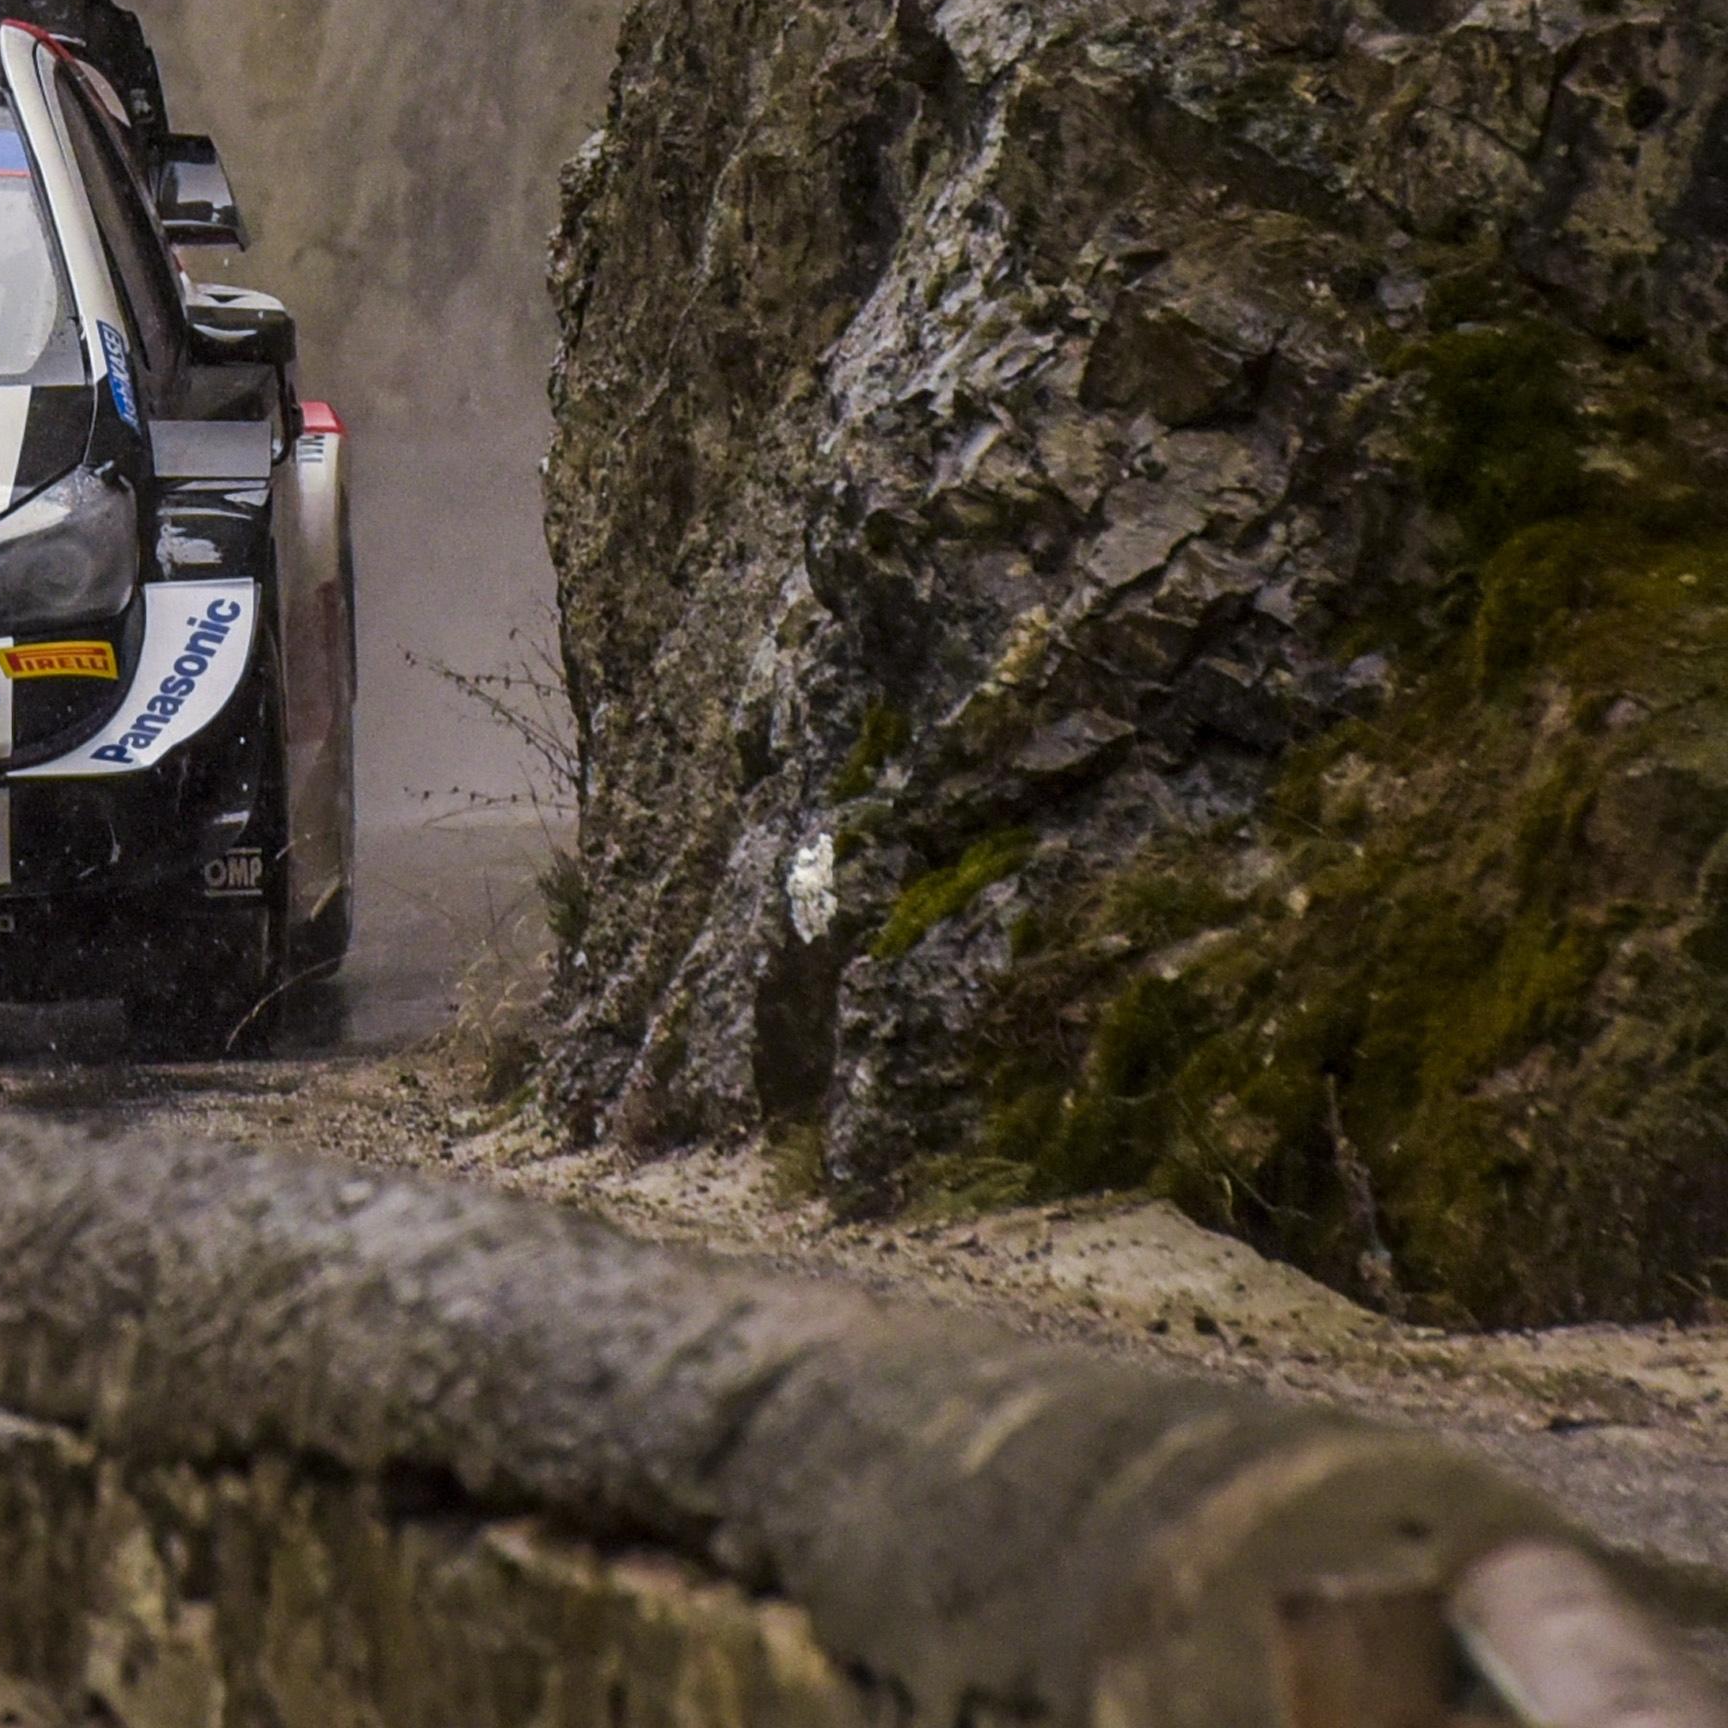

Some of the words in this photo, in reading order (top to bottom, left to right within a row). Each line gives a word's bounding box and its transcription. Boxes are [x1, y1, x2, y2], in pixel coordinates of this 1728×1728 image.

[5, 647, 109, 672] PIRELLI
[90, 598, 242, 764] Panasonic
[204, 857, 264, 887] OMP
